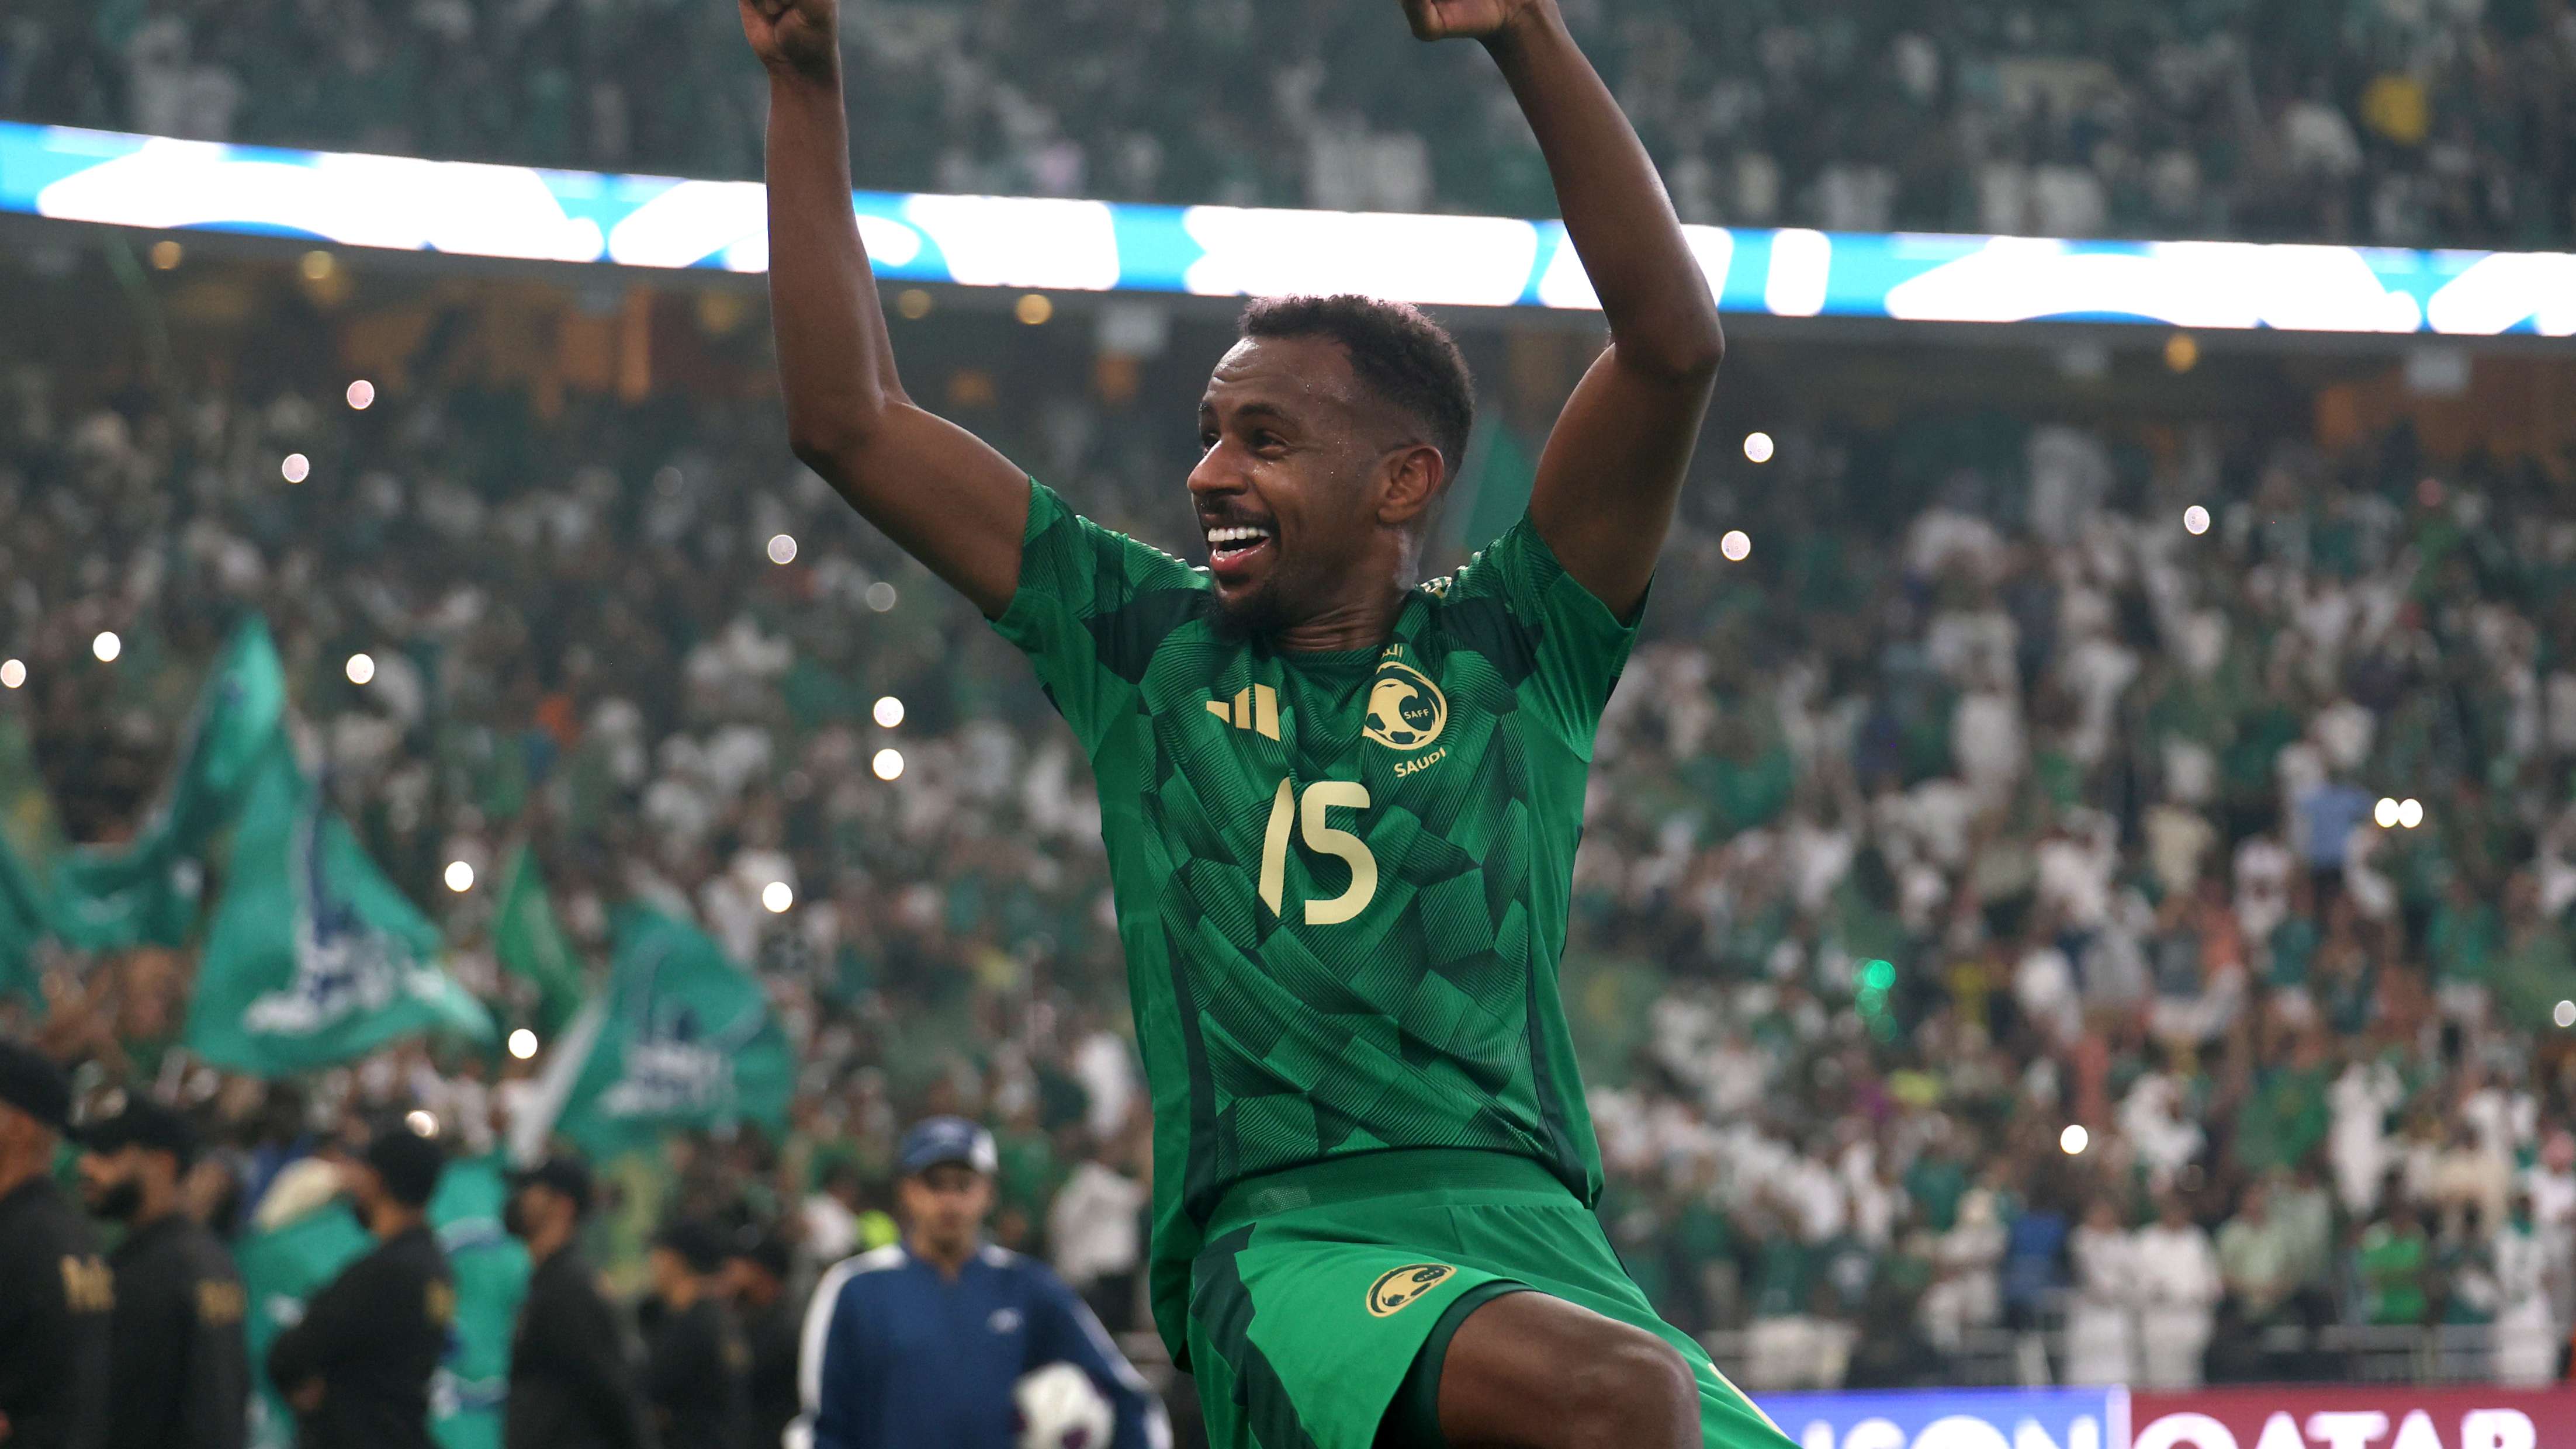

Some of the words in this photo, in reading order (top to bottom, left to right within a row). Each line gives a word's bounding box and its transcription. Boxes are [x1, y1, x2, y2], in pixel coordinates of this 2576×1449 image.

[1403, 708, 1429, 719] SAFF
[1393, 747, 1446, 778] SAUDI
[1258, 777, 1378, 925] 15
